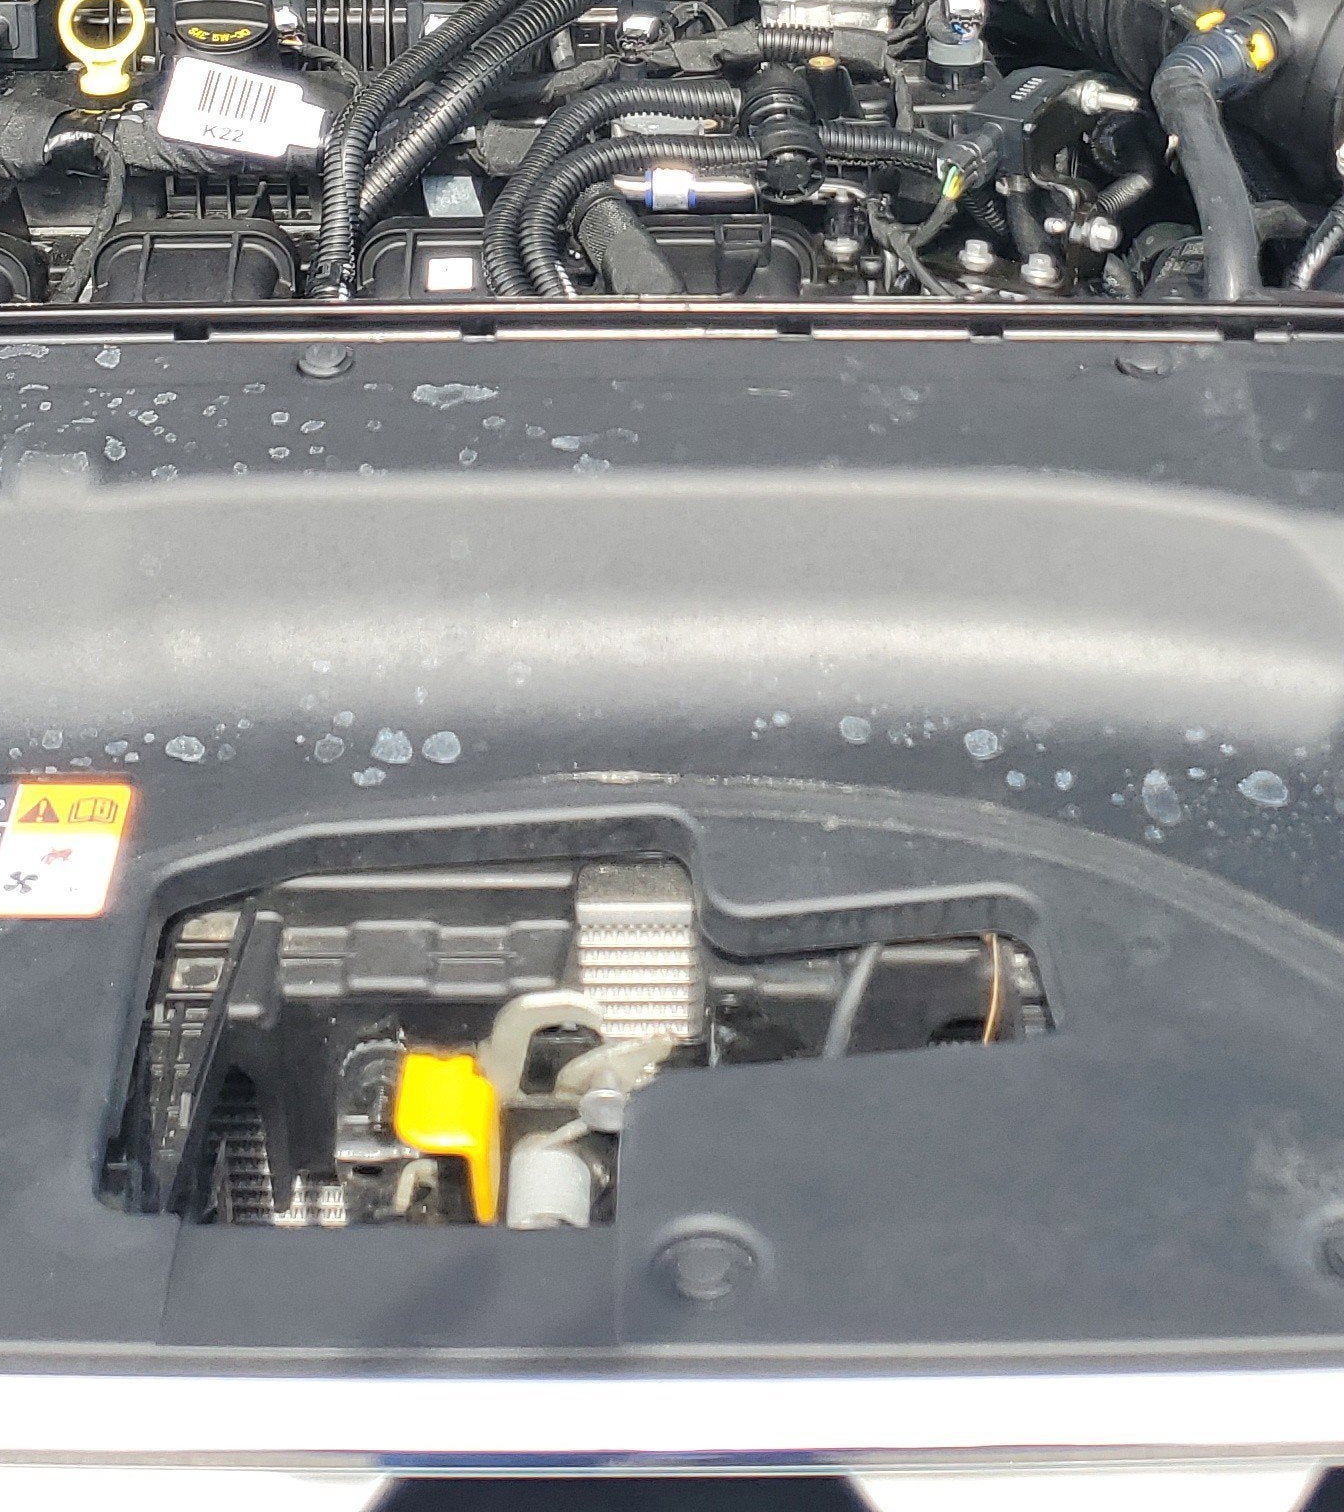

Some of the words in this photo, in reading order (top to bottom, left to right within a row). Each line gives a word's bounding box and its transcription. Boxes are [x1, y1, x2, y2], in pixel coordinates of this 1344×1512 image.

[188, 27, 210, 40] SAE
[212, 28, 251, 42] 5W-30
[203, 124, 244, 143] K22
